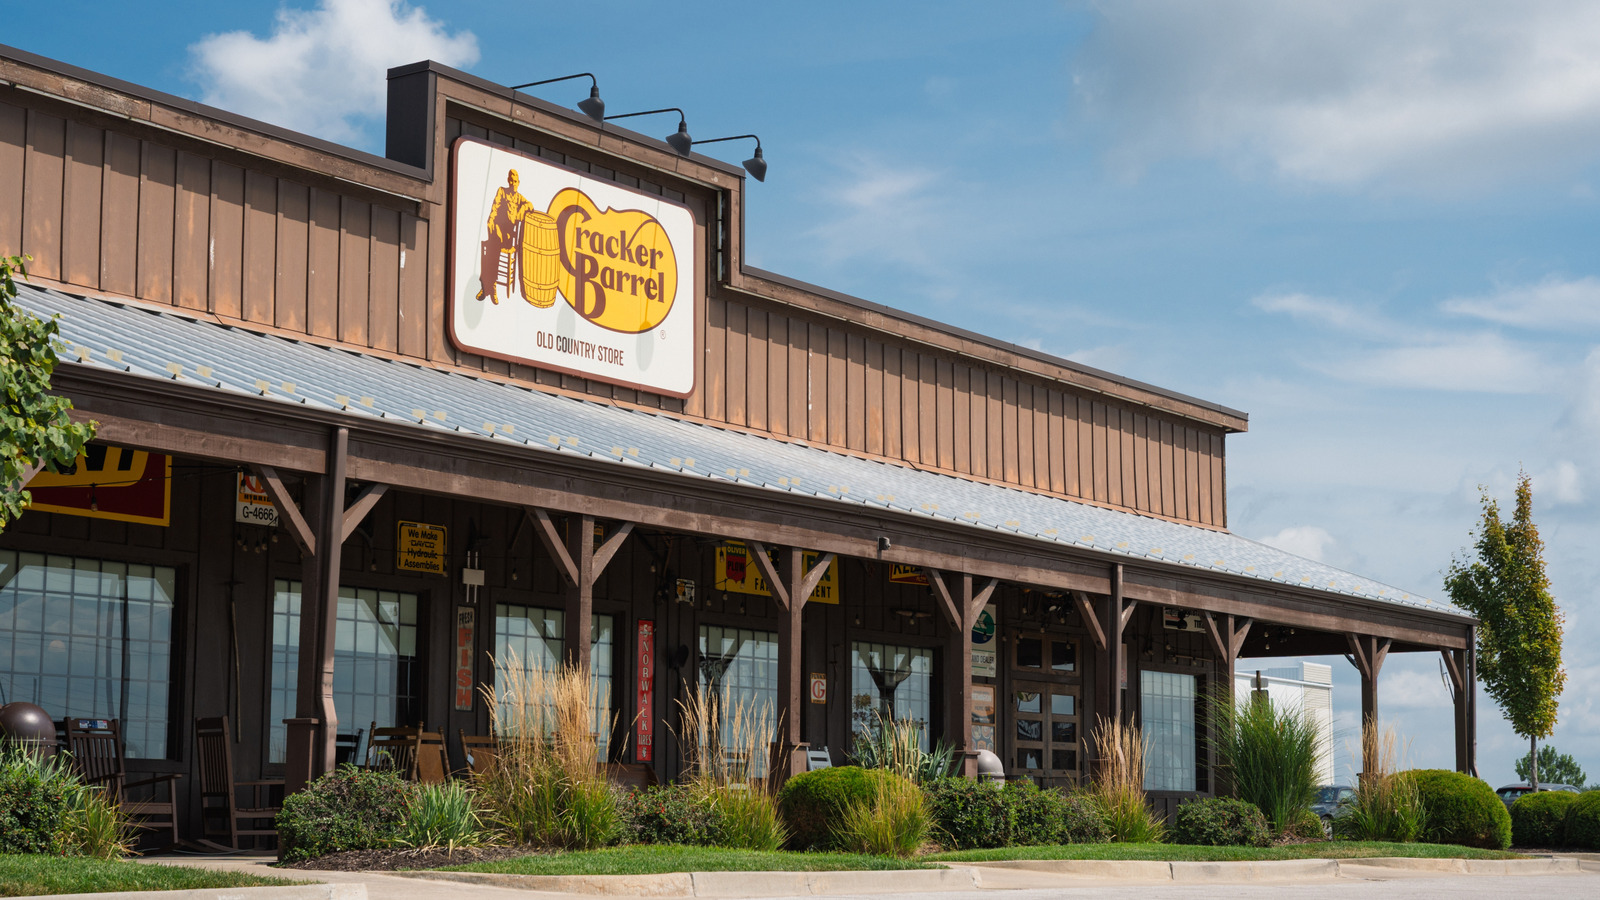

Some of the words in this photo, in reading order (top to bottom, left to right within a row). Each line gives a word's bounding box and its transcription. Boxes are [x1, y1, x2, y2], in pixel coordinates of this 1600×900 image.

[556, 205, 664, 276] Cracker
[574, 251, 665, 319] Barrel
[536, 330, 554, 351] OLD
[555, 335, 597, 360] COUNTRY
[597, 345, 625, 367] STORE
[242, 505, 274, 521] G-4666
[408, 528, 419, 538] We
[421, 529, 438, 541] Make
[407, 547, 438, 560] Hydraulic
[727, 545, 746, 555] OLIVER
[403, 558, 440, 571] Assemblies
[458, 611, 474, 626] FRESH
[456, 627, 472, 708] FISH
[641, 640, 651, 731] NORWALK
[638, 733, 652, 746] TIRES
